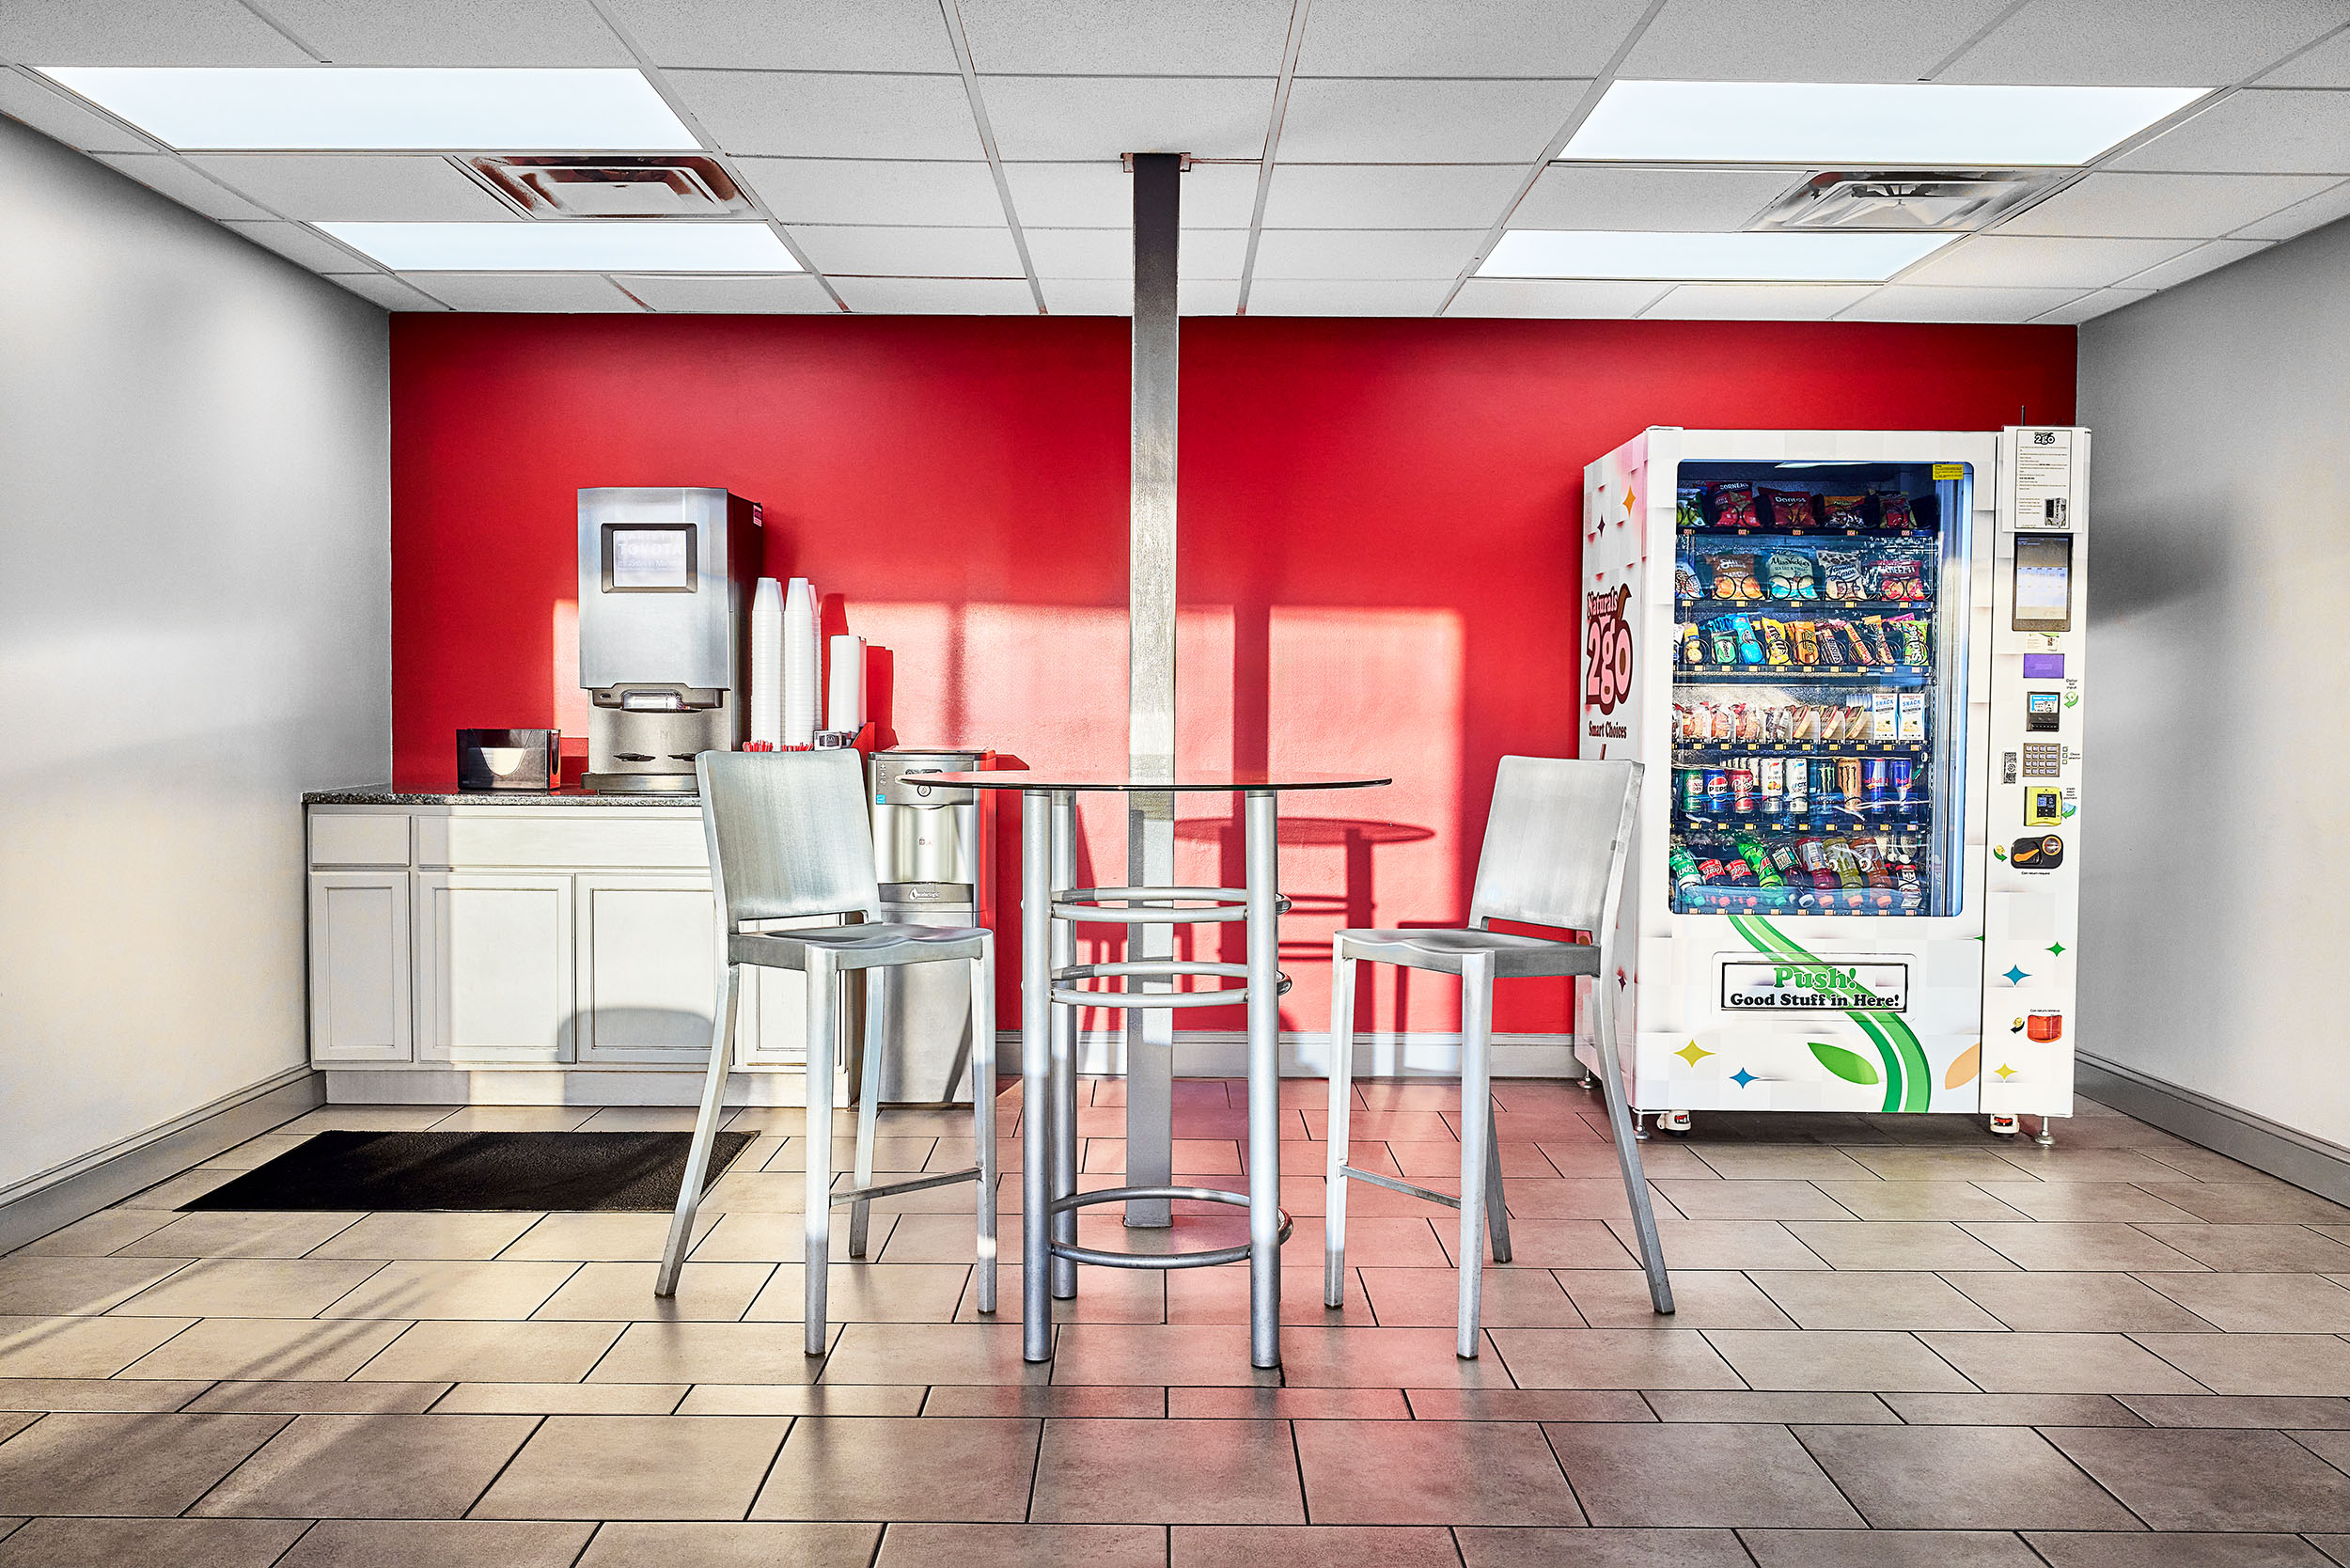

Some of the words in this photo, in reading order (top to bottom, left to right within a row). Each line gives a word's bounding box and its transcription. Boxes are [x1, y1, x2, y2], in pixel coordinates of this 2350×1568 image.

[1586, 587, 1619, 618] Naturals
[1587, 619, 1633, 713] 2go
[1589, 720, 1605, 738] Smart
[1605, 721, 1627, 739] Choices
[1773, 967, 1857, 989] Push!
[1730, 993, 1776, 1006] Good
[1779, 993, 1826, 1007] Stuff
[1830, 994, 1848, 1006] in
[1854, 994, 1900, 1007] Here!
